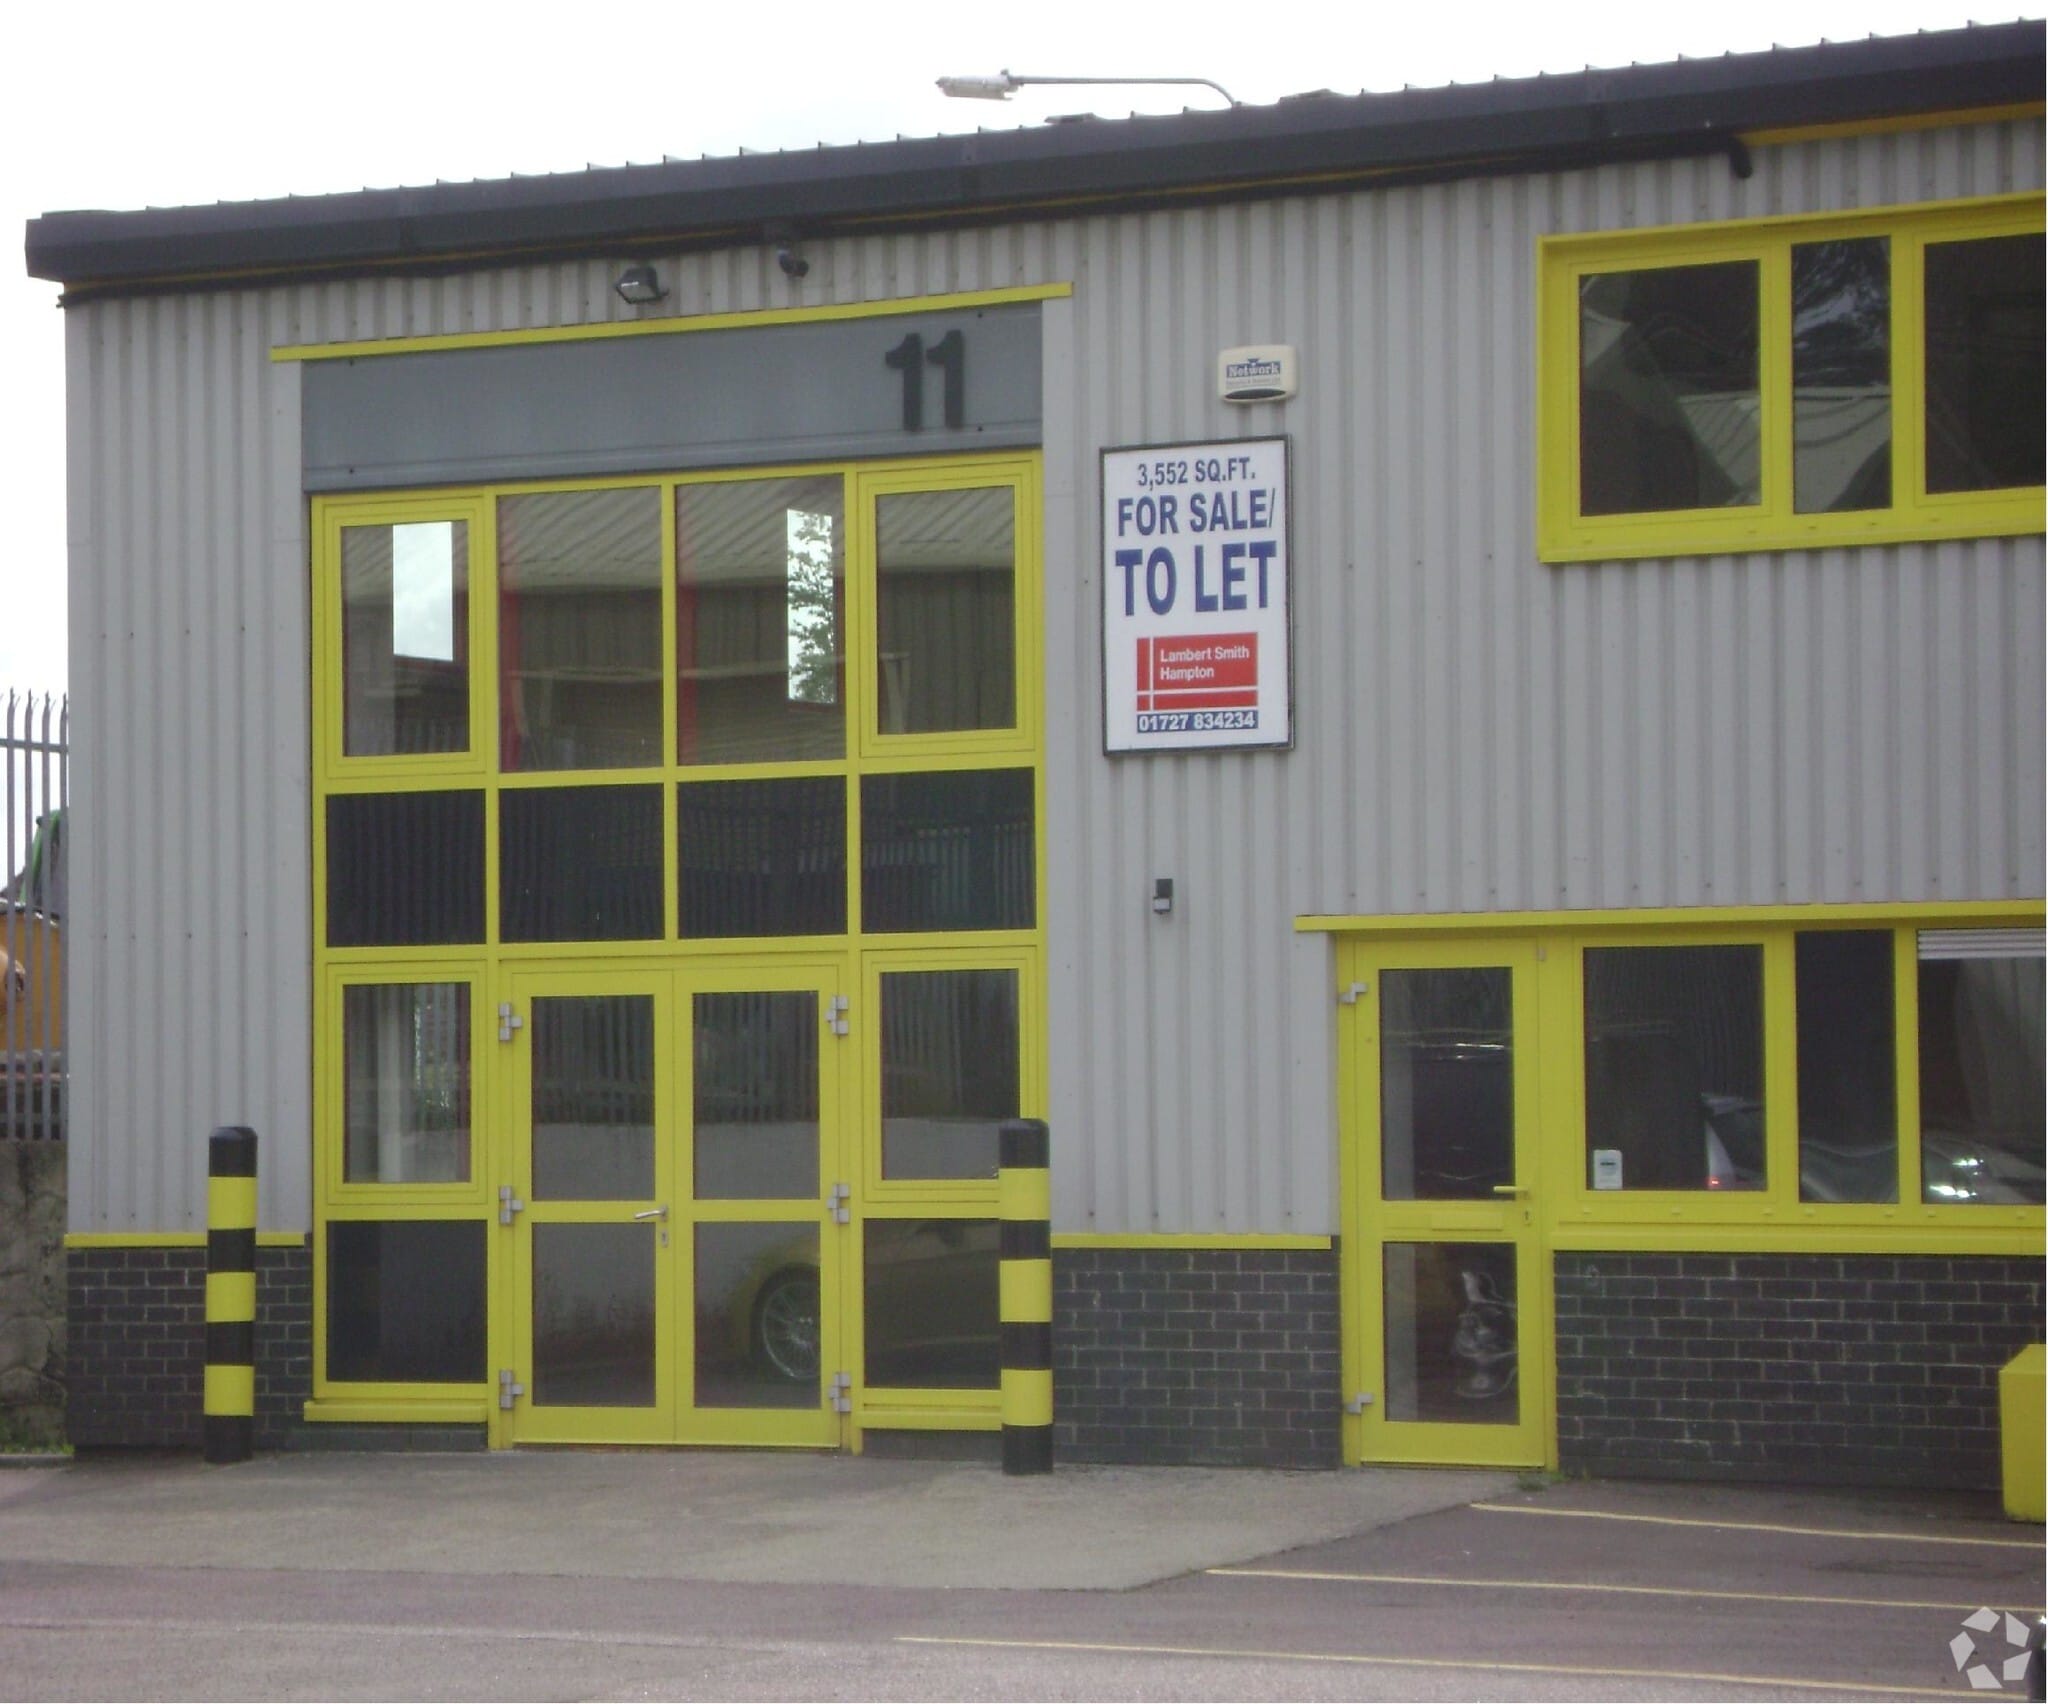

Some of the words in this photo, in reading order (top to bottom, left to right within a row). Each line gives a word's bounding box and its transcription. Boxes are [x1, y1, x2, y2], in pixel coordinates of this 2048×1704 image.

[885, 329, 964, 433] 11
[1228, 362, 1279, 377] Network
[1137, 461, 1188, 491] 3,552
[1195, 456, 1256, 484] SQ.FT.
[1118, 494, 1179, 537] FOR
[1189, 487, 1276, 532] SALE/
[1115, 546, 1177, 616] TO
[1194, 540, 1277, 612] LET
[1160, 647, 1212, 663] Lambert
[1214, 645, 1250, 660] Smith
[1160, 666, 1215, 682] Hampton
[1138, 714, 1189, 732] 01727
[1193, 711, 1256, 730] 834234
